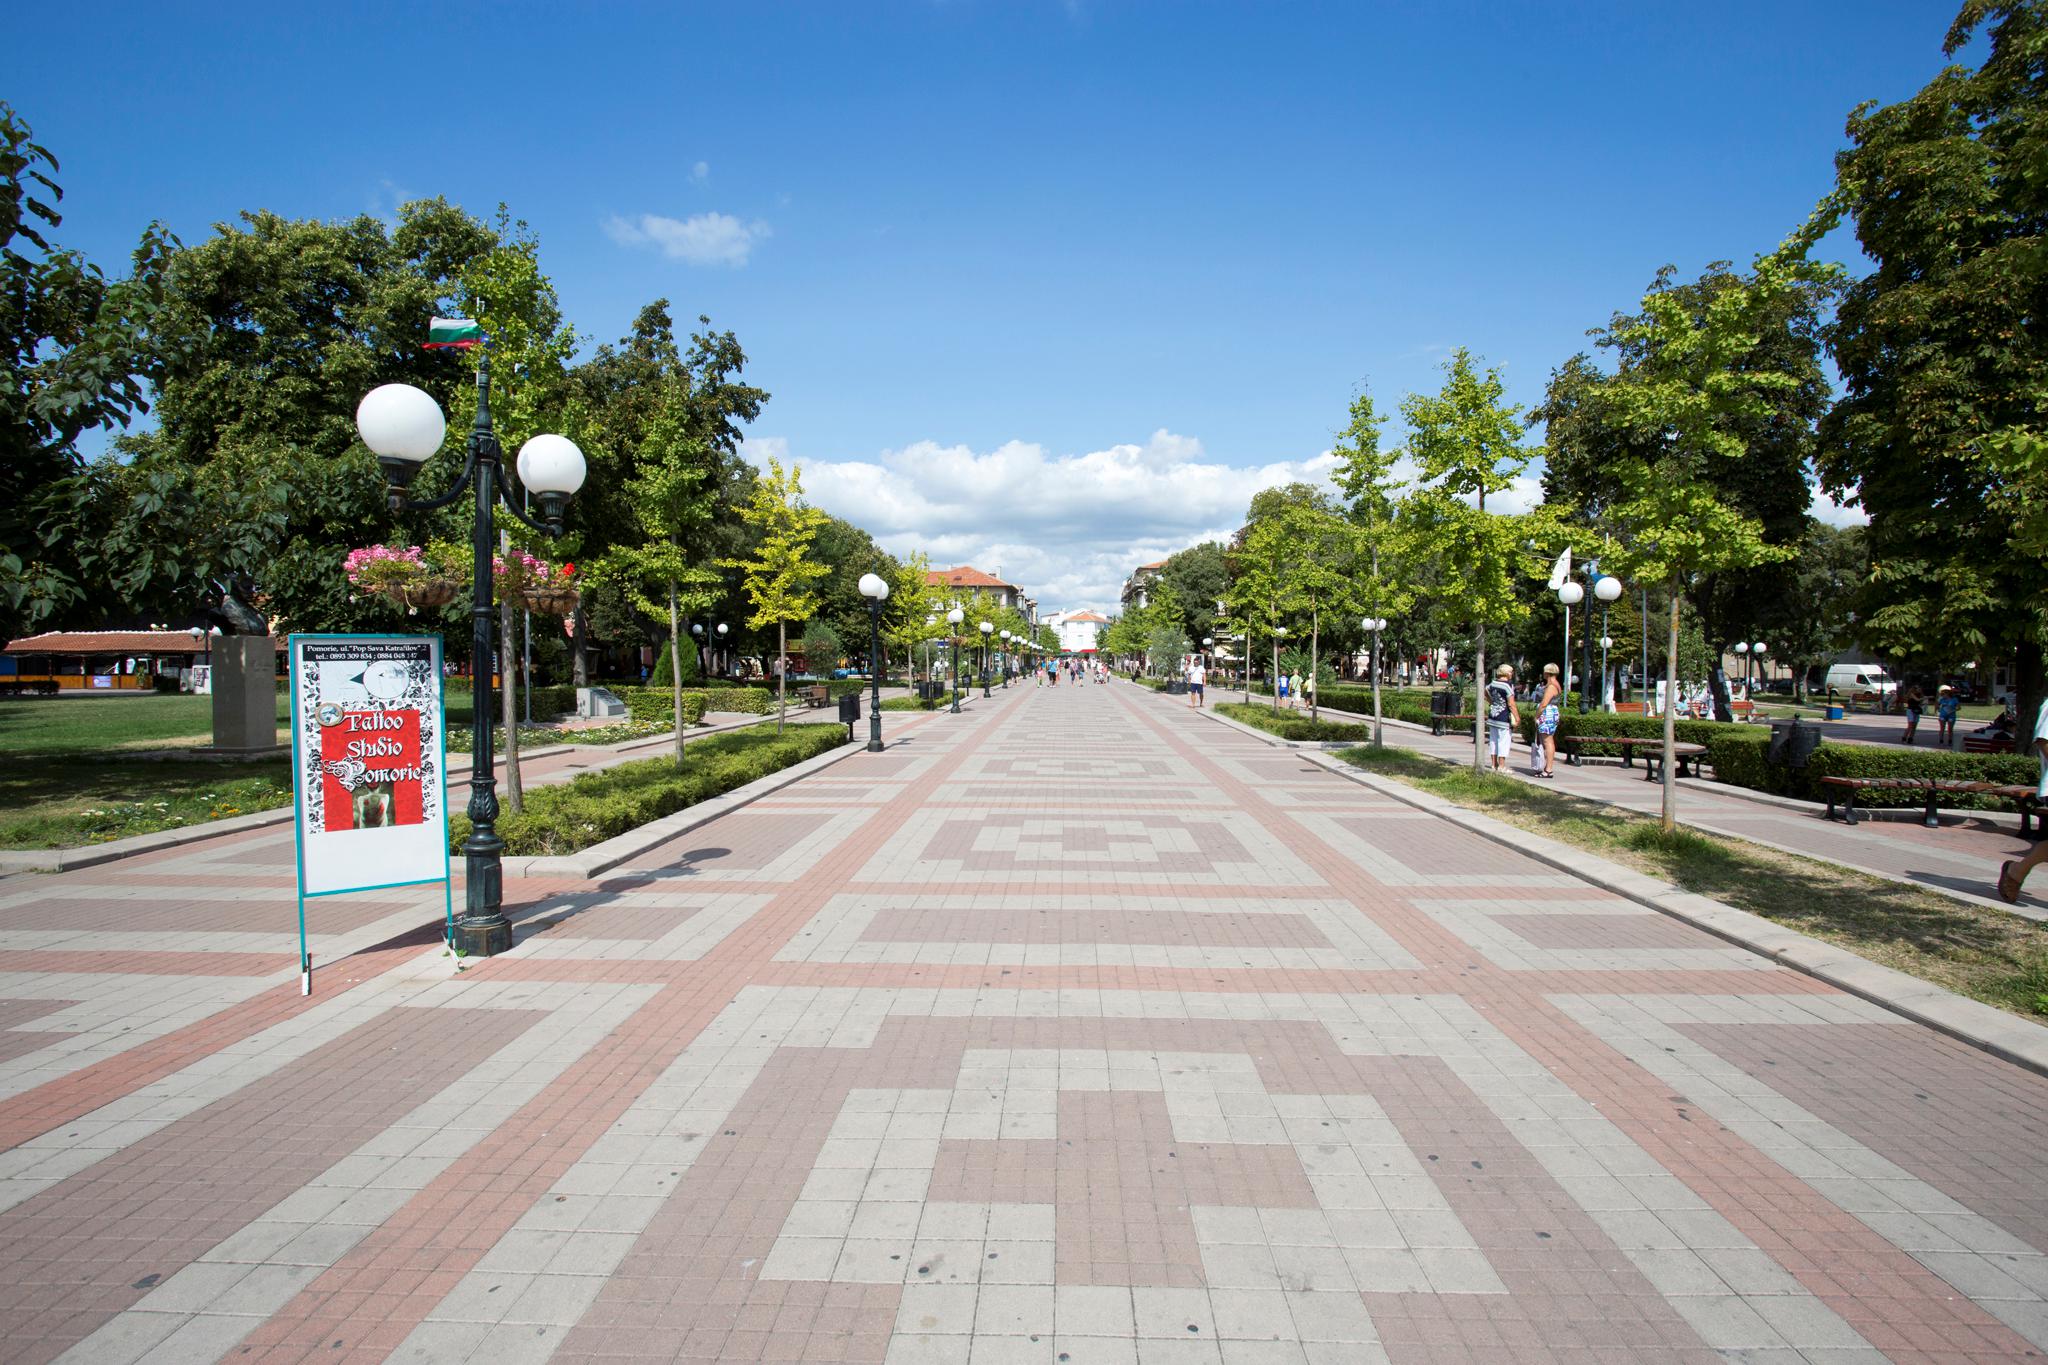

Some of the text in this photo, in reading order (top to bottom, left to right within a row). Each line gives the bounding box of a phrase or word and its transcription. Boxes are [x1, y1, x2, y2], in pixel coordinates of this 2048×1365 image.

[339, 711, 404, 733] Tattoo
[346, 737, 402, 758] Studio
[322, 757, 422, 792] Pomorie
